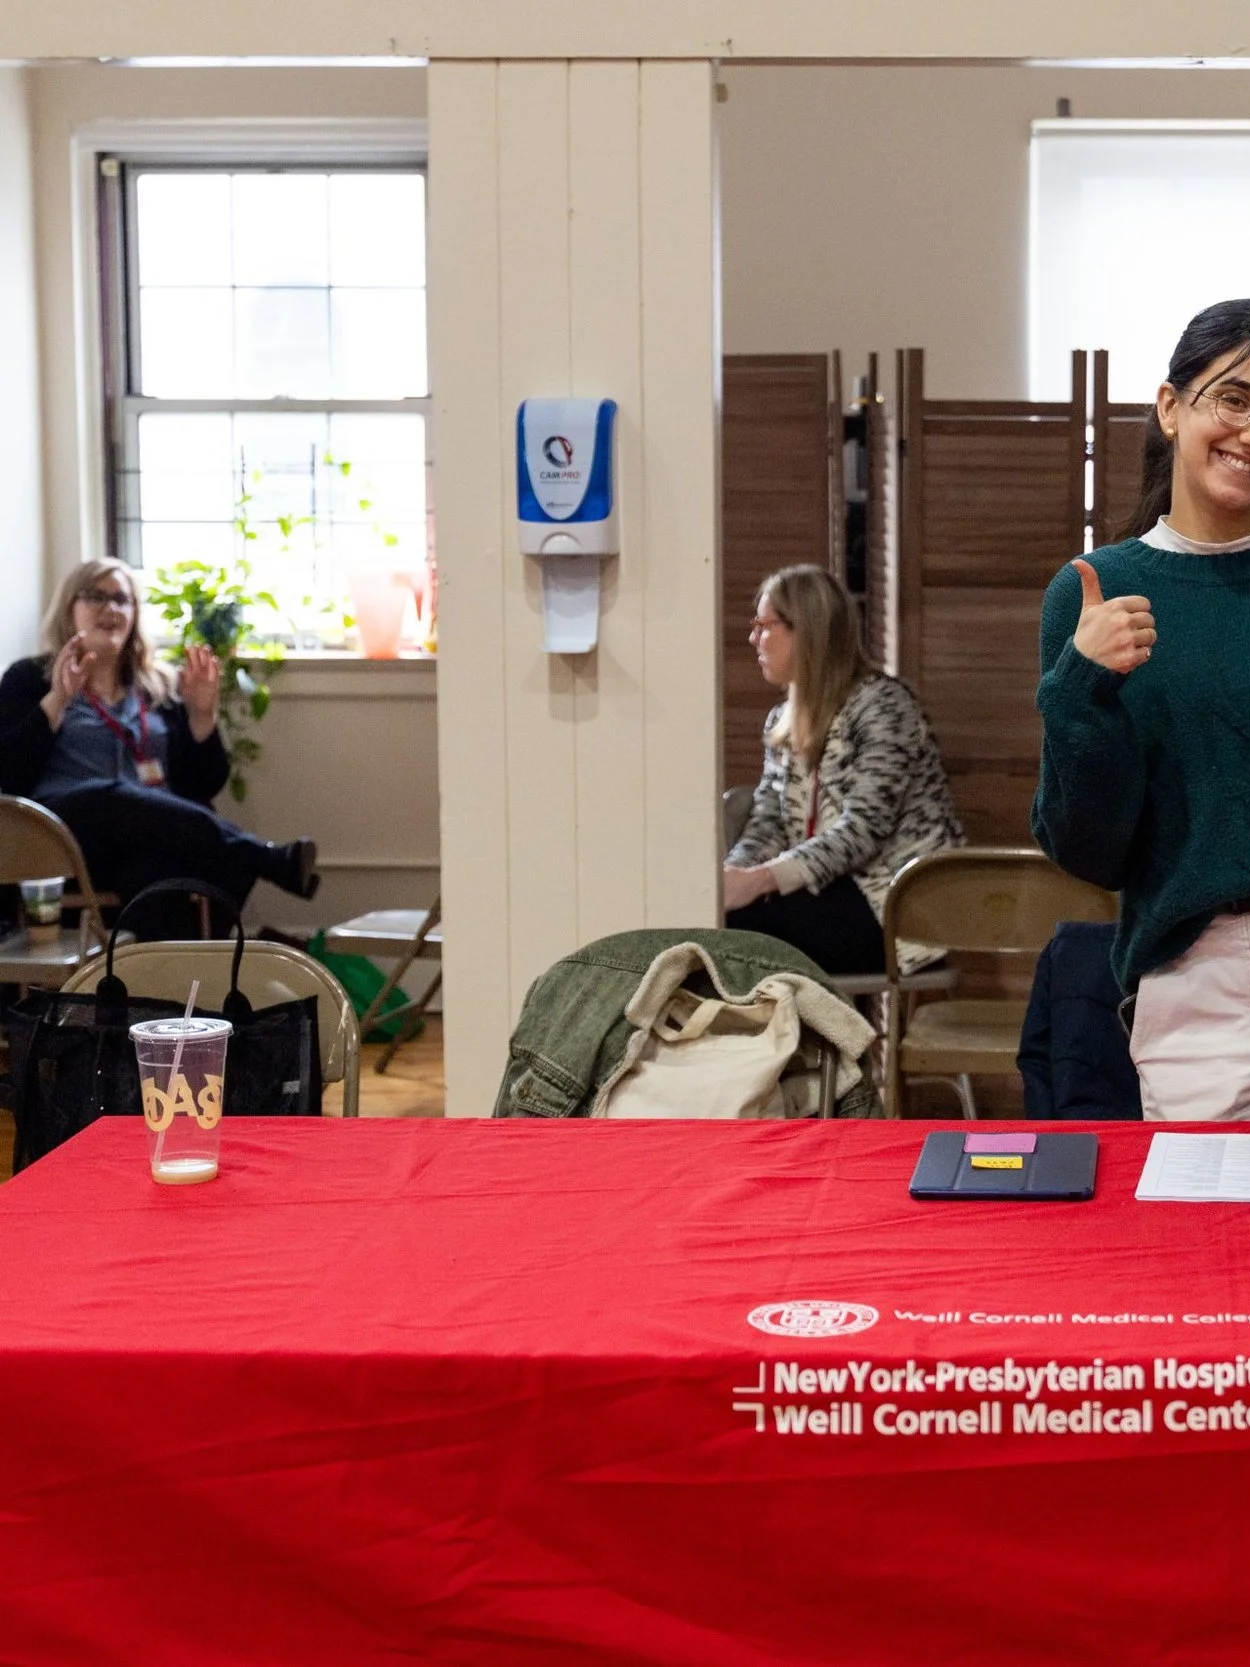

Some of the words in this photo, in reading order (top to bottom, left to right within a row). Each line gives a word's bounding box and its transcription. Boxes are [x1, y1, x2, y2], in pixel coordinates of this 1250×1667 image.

[893, 1309, 960, 1323] Weill
[968, 1311, 1063, 1324] Cornell
[1071, 1312, 1174, 1325] Medical
[773, 1357, 1145, 1400] NewYork-Presbyterian
[773, 1402, 863, 1435] Weill
[873, 1401, 1001, 1435] Cornell
[1012, 1399, 1153, 1434] Medical
